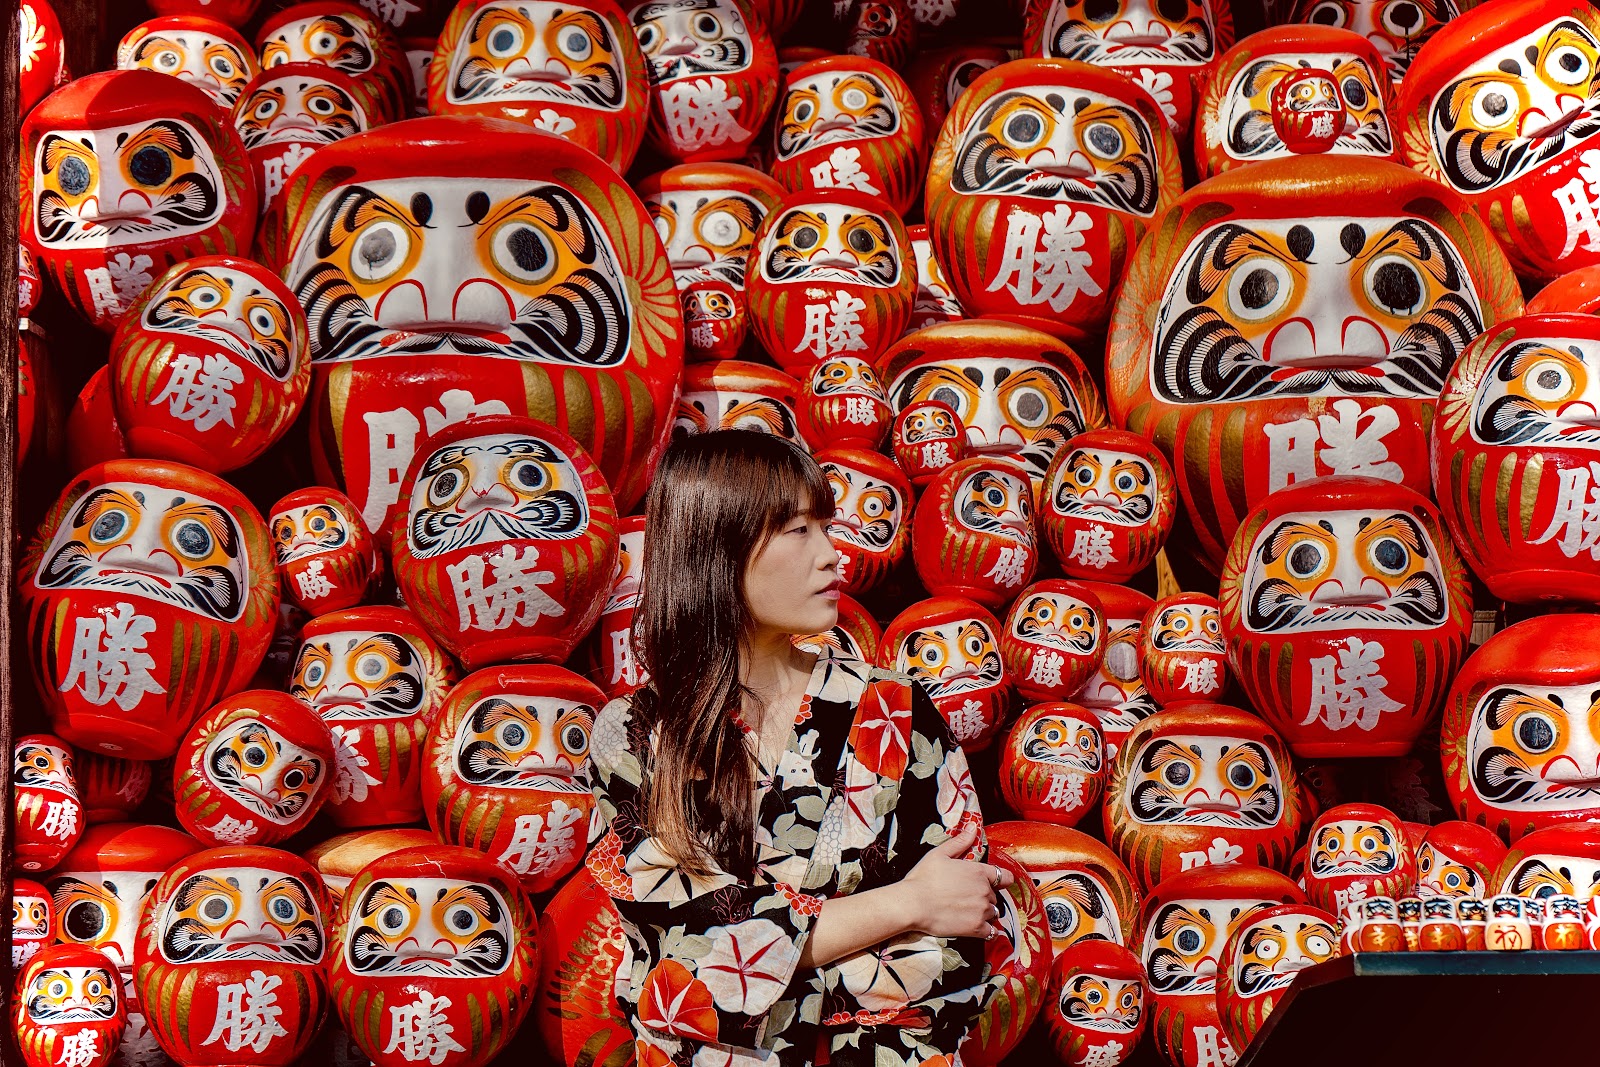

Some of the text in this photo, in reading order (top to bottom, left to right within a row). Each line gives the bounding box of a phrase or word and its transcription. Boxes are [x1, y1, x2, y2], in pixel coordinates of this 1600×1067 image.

[662, 76, 752, 151] 勝
[1307, 111, 1334, 138] 勝
[985, 203, 1104, 312] 勝
[691, 322, 719, 348] 勝
[793, 290, 869, 359] 勝
[151, 352, 244, 432] 勝
[843, 397, 878, 426] 勝
[920, 442, 954, 468] 勝
[984, 546, 1028, 588] 勝
[1068, 525, 1118, 569] 勝
[296, 560, 337, 600] 勝
[445, 544, 565, 632] 勝
[58, 602, 167, 711] 勝
[1025, 651, 1064, 687] 勝
[1178, 658, 1219, 694] 勝
[1300, 636, 1406, 731] 勝
[948, 699, 990, 741] 勝
[1041, 773, 1086, 812] 勝
[37, 799, 78, 840] 勝
[498, 800, 583, 875] 勝
[200, 970, 288, 1053] 勝
[382, 989, 467, 1066] 勝
[54, 1028, 101, 1067] 勝
